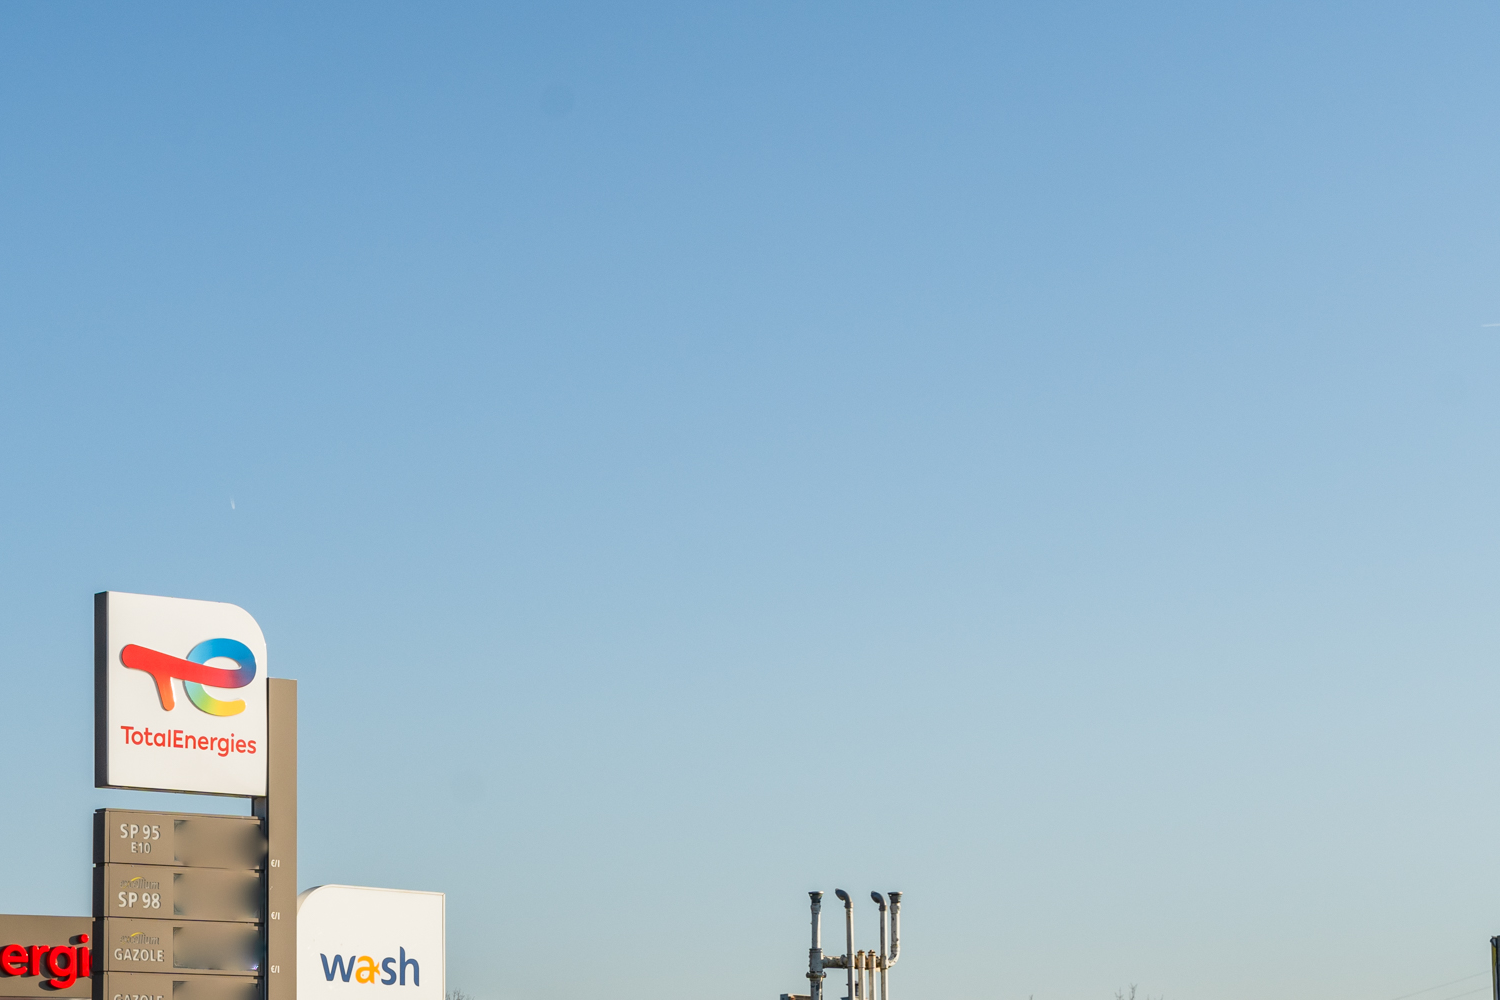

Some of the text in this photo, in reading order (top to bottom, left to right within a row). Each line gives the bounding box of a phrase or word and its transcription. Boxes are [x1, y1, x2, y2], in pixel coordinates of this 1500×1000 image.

[120, 725, 257, 757] TotalEnergies
[120, 823, 161, 840] SP 95
[131, 842, 152, 854] E10
[118, 891, 161, 909] SP 98
[114, 948, 165, 963] GAZOLE
[320, 946, 420, 987] wash
